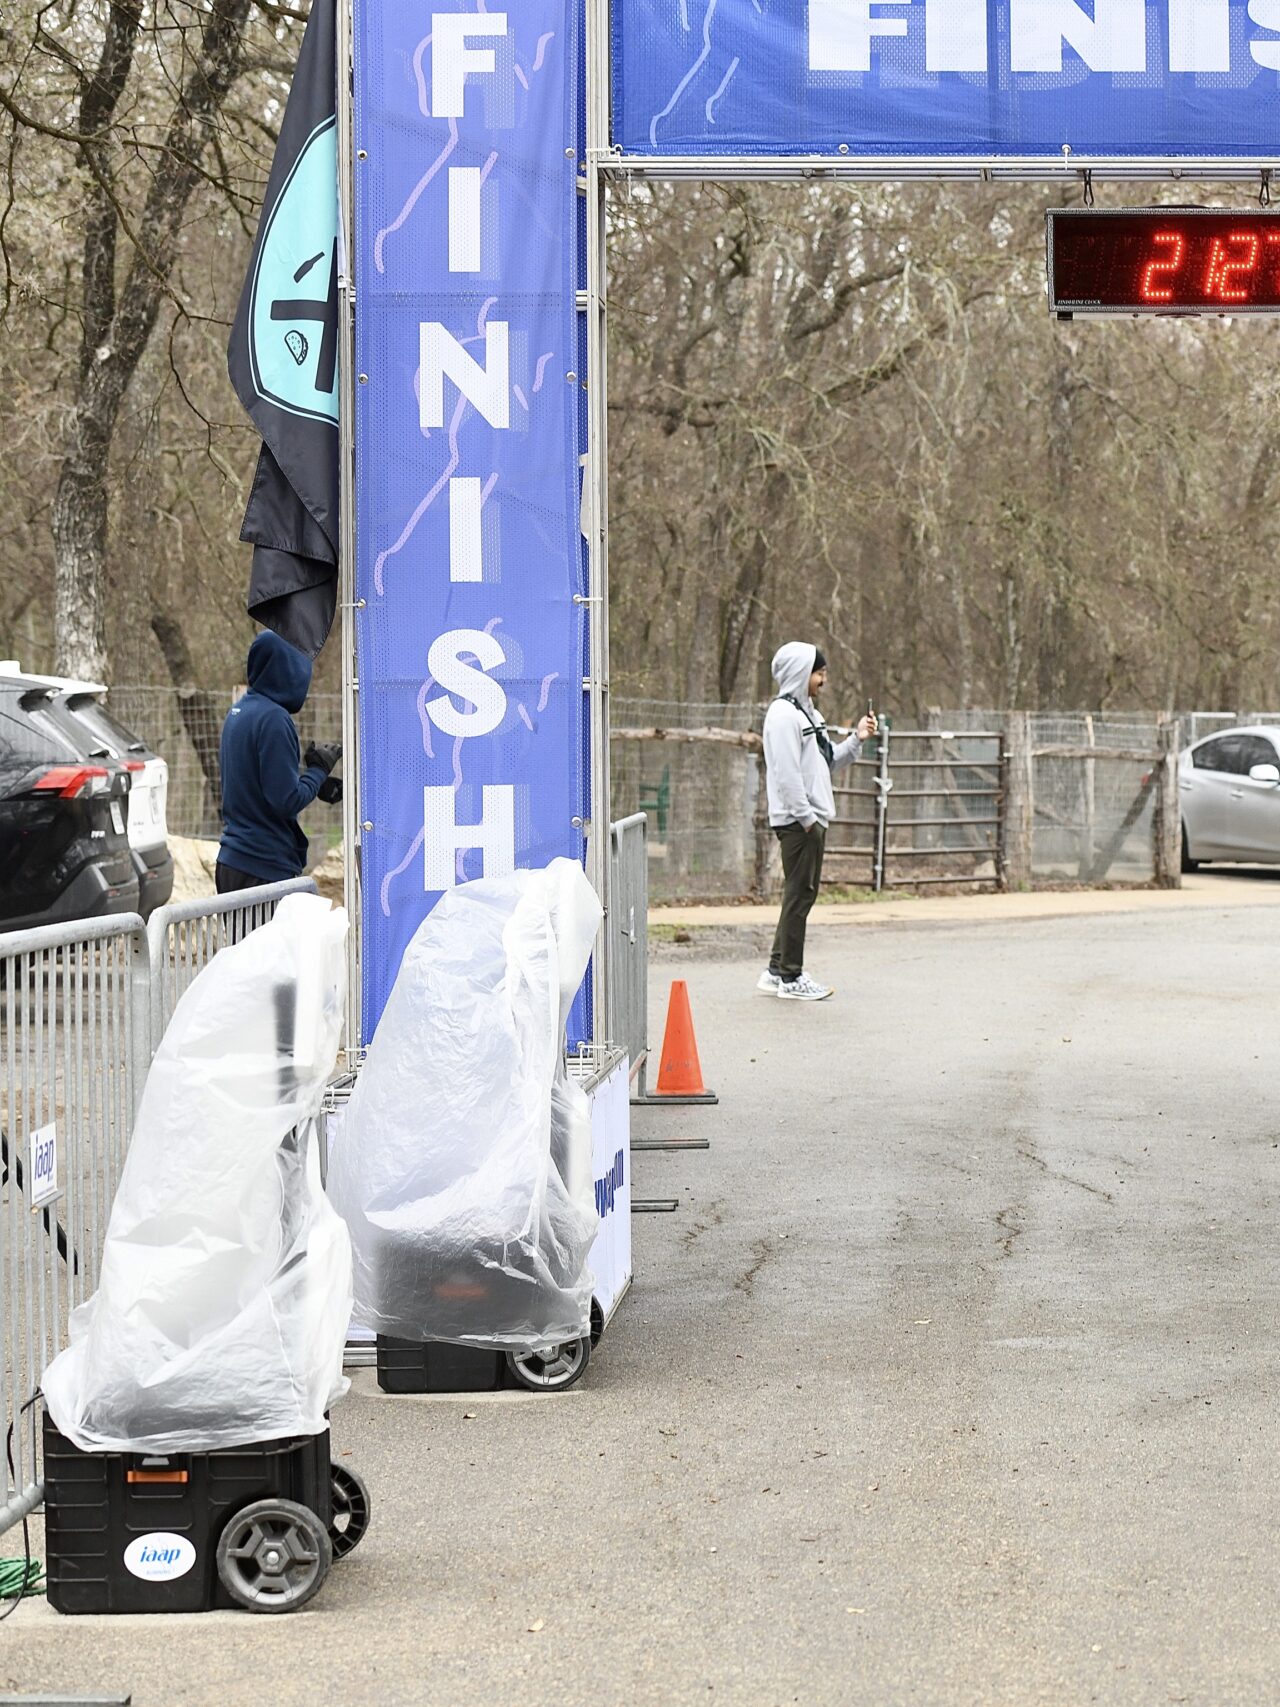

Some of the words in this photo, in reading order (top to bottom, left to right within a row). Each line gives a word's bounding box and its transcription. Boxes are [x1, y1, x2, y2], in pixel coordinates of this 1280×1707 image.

[420, 12, 515, 891] FINISH
[34, 1133, 54, 1182] iaap
[140, 1546, 181, 1564] iaap
